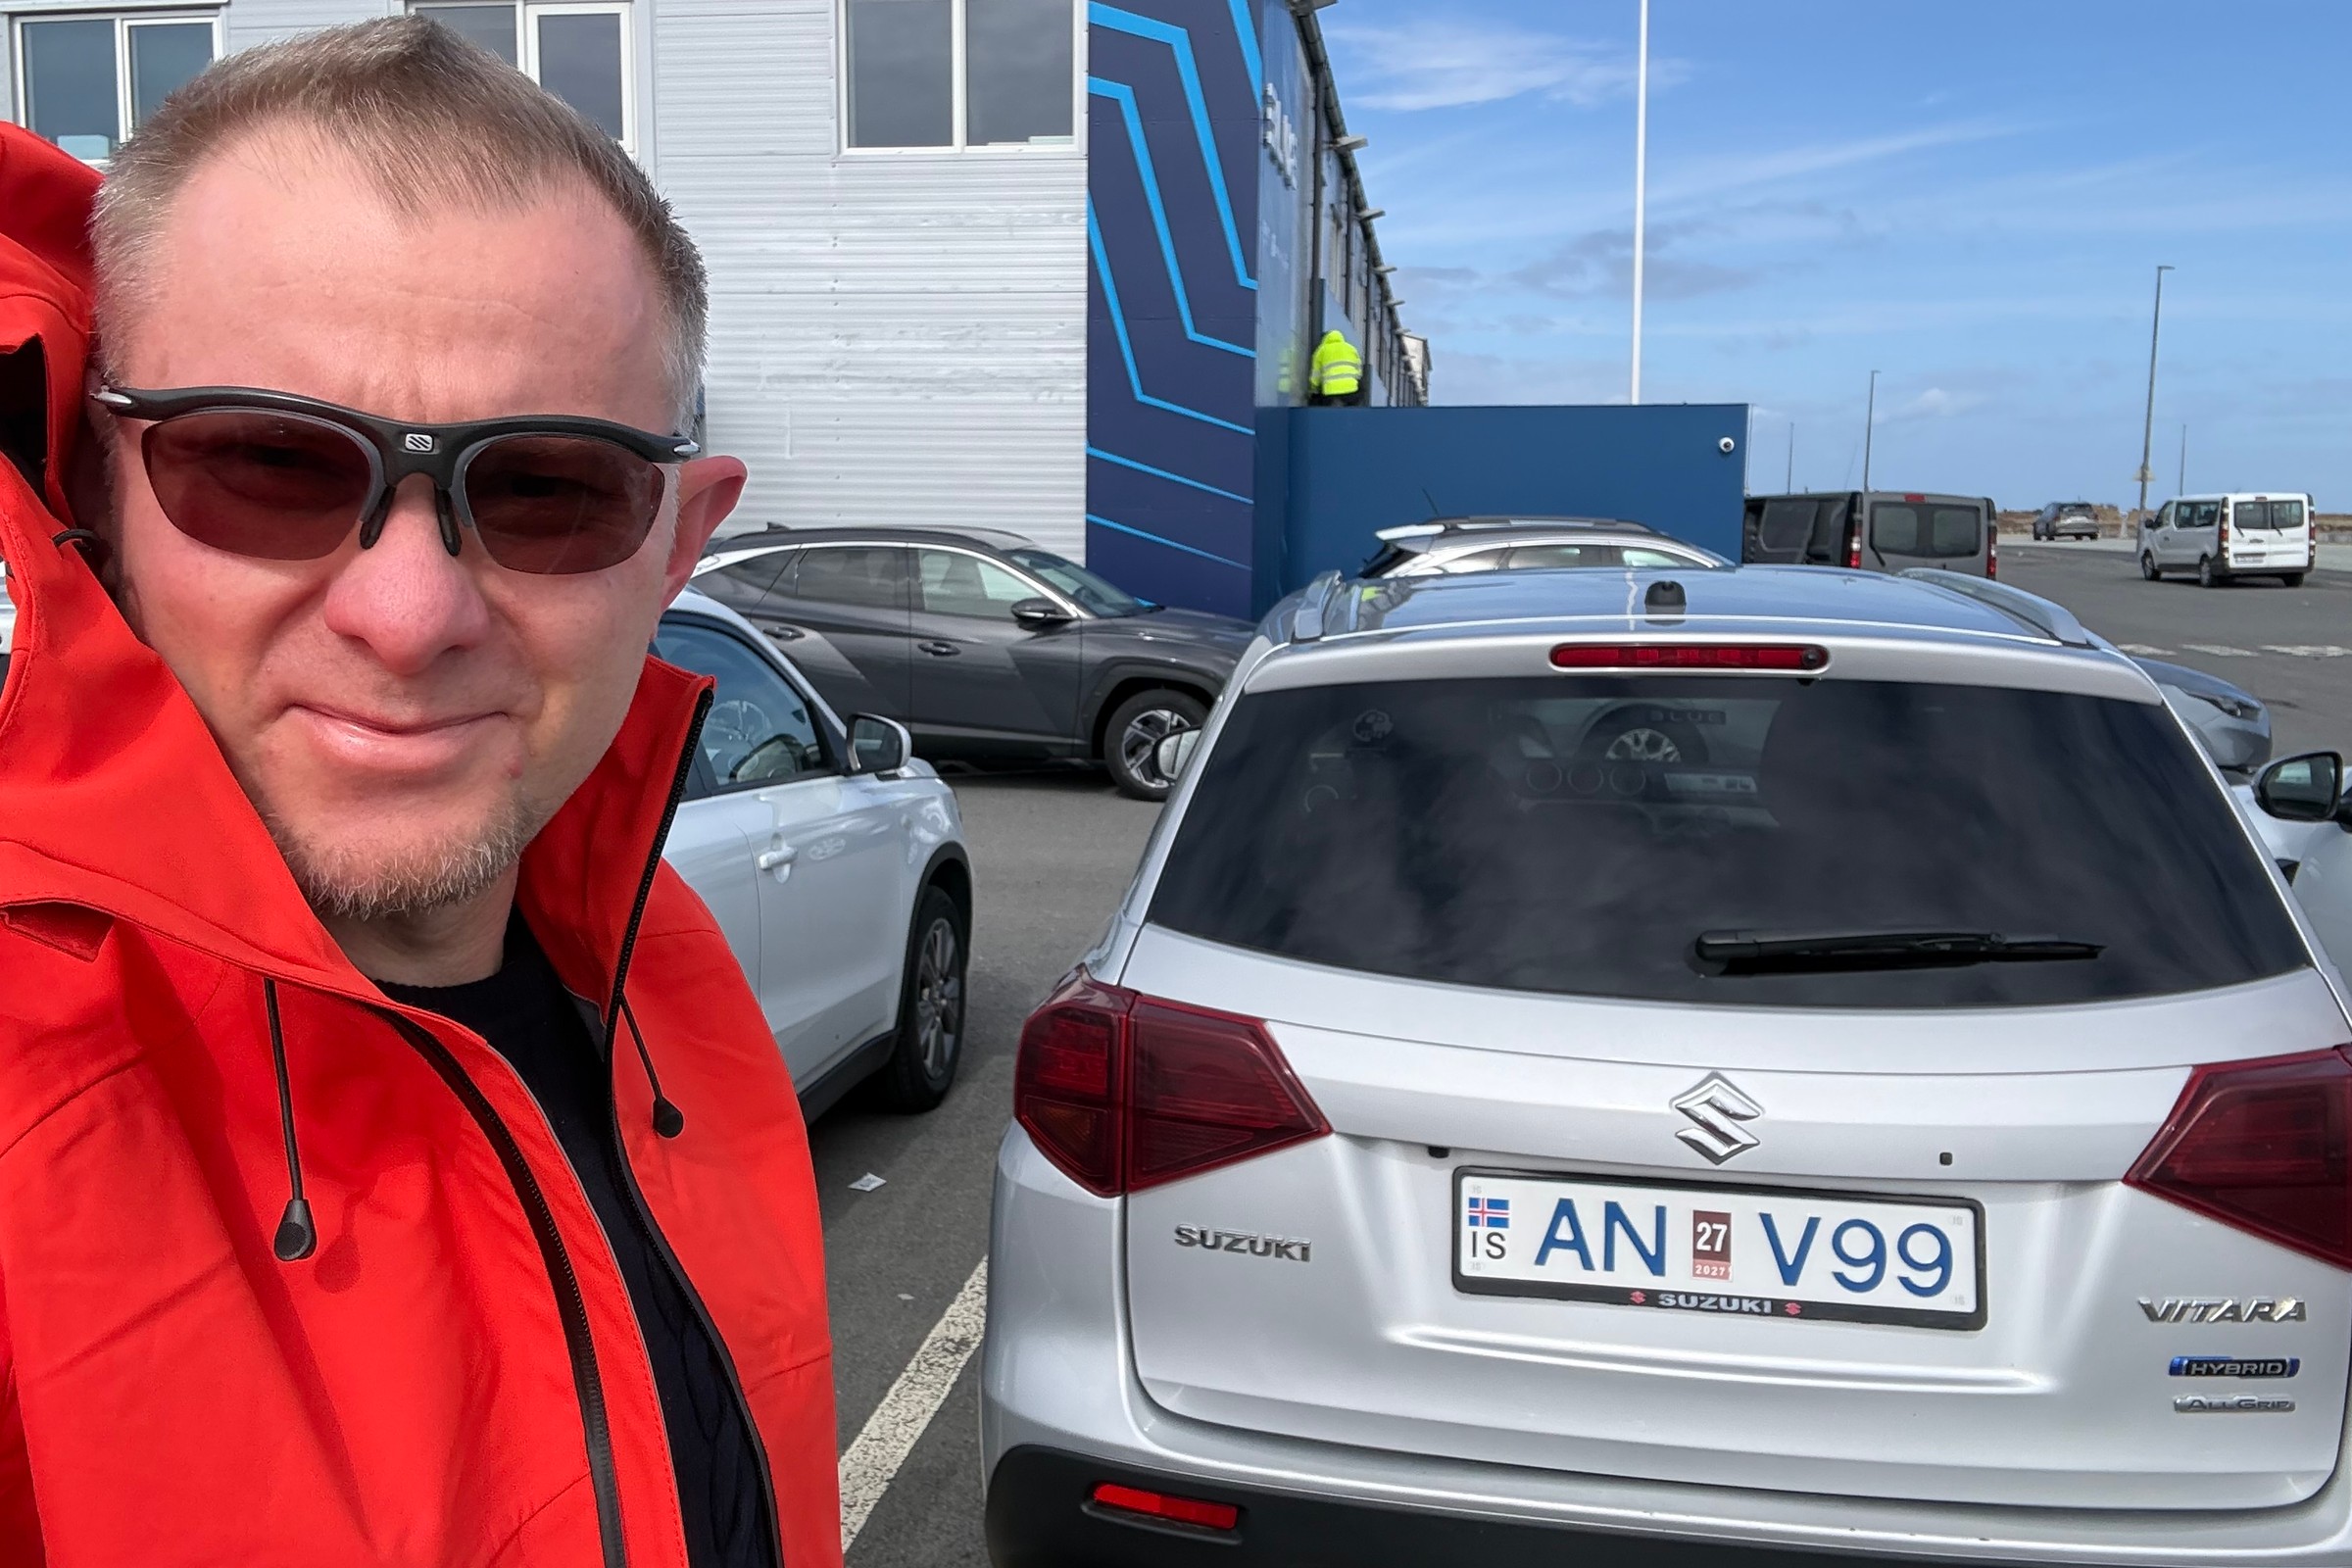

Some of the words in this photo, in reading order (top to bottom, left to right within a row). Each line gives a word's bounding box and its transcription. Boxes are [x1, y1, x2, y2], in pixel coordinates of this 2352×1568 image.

[1175, 1223, 1311, 1262] SUZUKI
[1472, 1230, 1506, 1260] IS
[1535, 1198, 1667, 1276] AN
[1759, 1212, 1953, 1298] V99
[1696, 1221, 1728, 1252] 27
[1695, 1264, 1726, 1276] 2027
[1658, 1293, 1772, 1313] SUZUKI
[2137, 1297, 2307, 1322] VITARA
[2190, 1361, 2283, 1375] HYBRID
